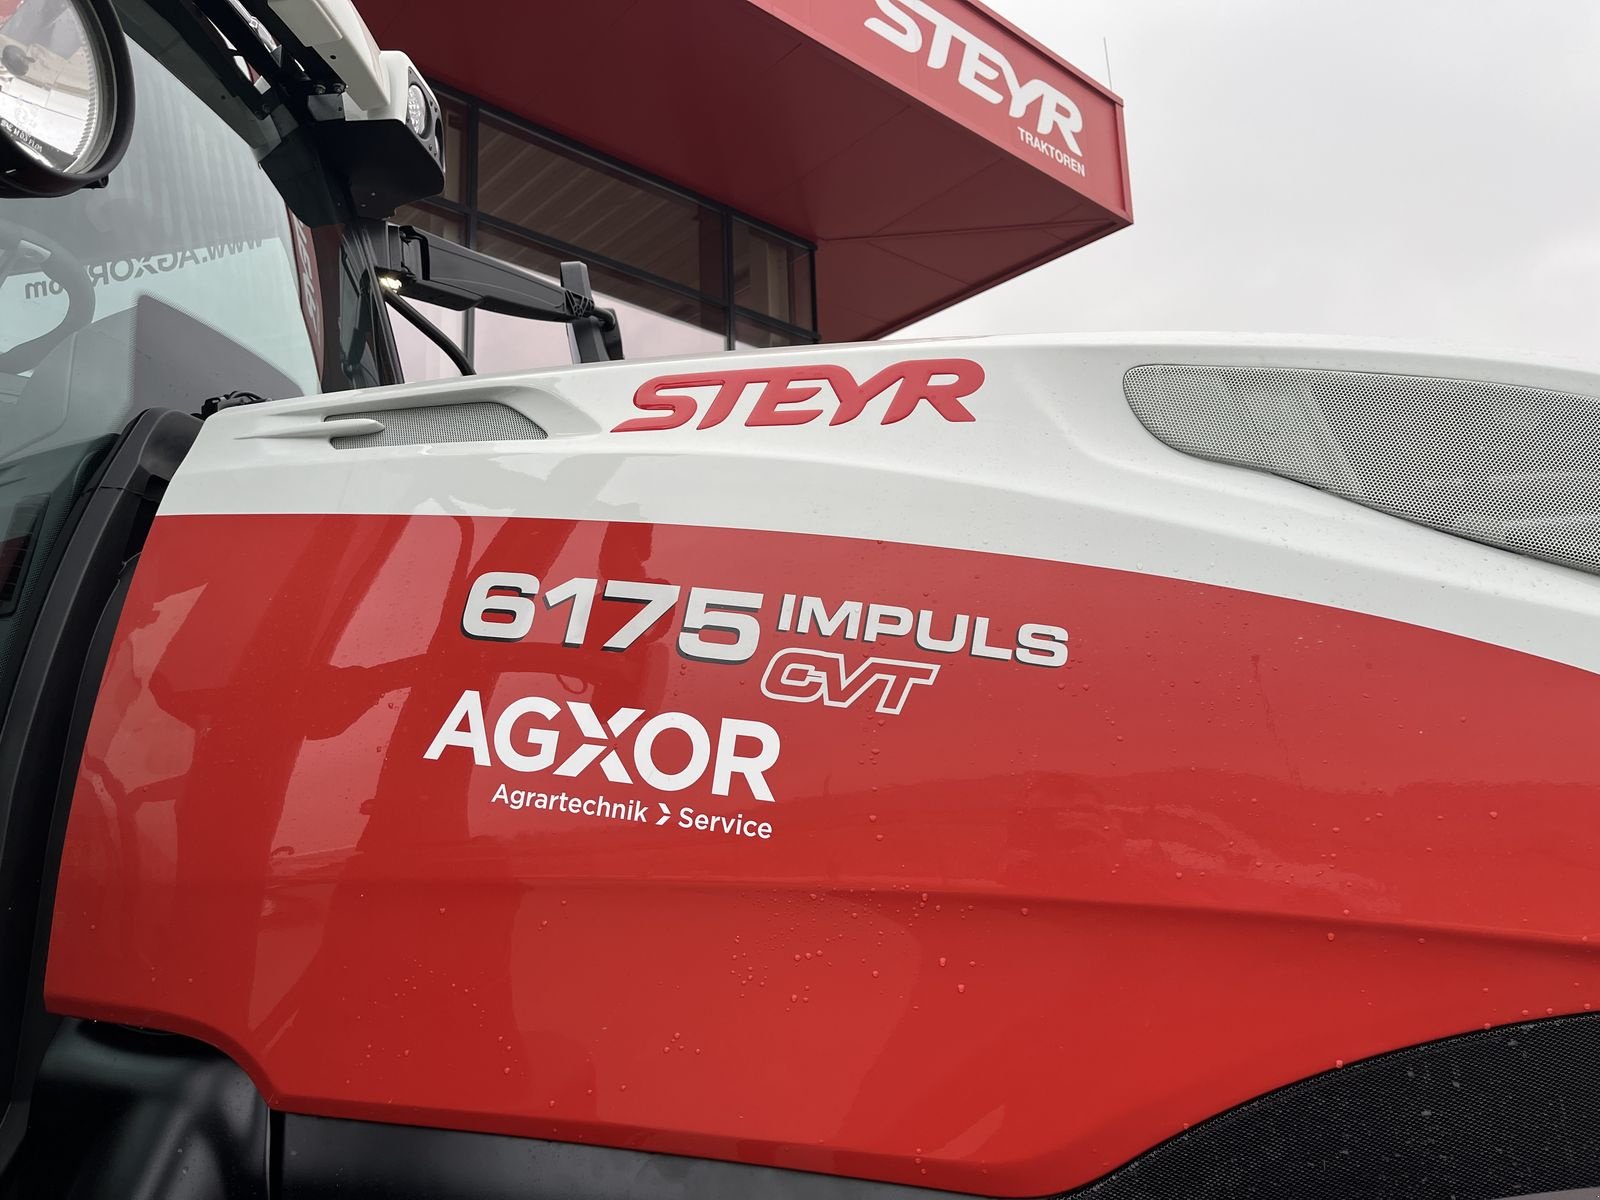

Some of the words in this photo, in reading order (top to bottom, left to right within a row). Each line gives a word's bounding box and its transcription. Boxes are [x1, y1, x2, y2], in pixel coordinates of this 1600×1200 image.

[864, 0, 1082, 157] STEYR
[1017, 126, 1086, 177] TRAKTOREN
[610, 358, 985, 433] STEYR
[460, 571, 764, 665] 6175
[776, 593, 1070, 668] IMPULS
[760, 647, 941, 715] CVT
[422, 689, 781, 803] AGXOR
[491, 784, 649, 823] Agrartechnik
[677, 807, 774, 839] Service
